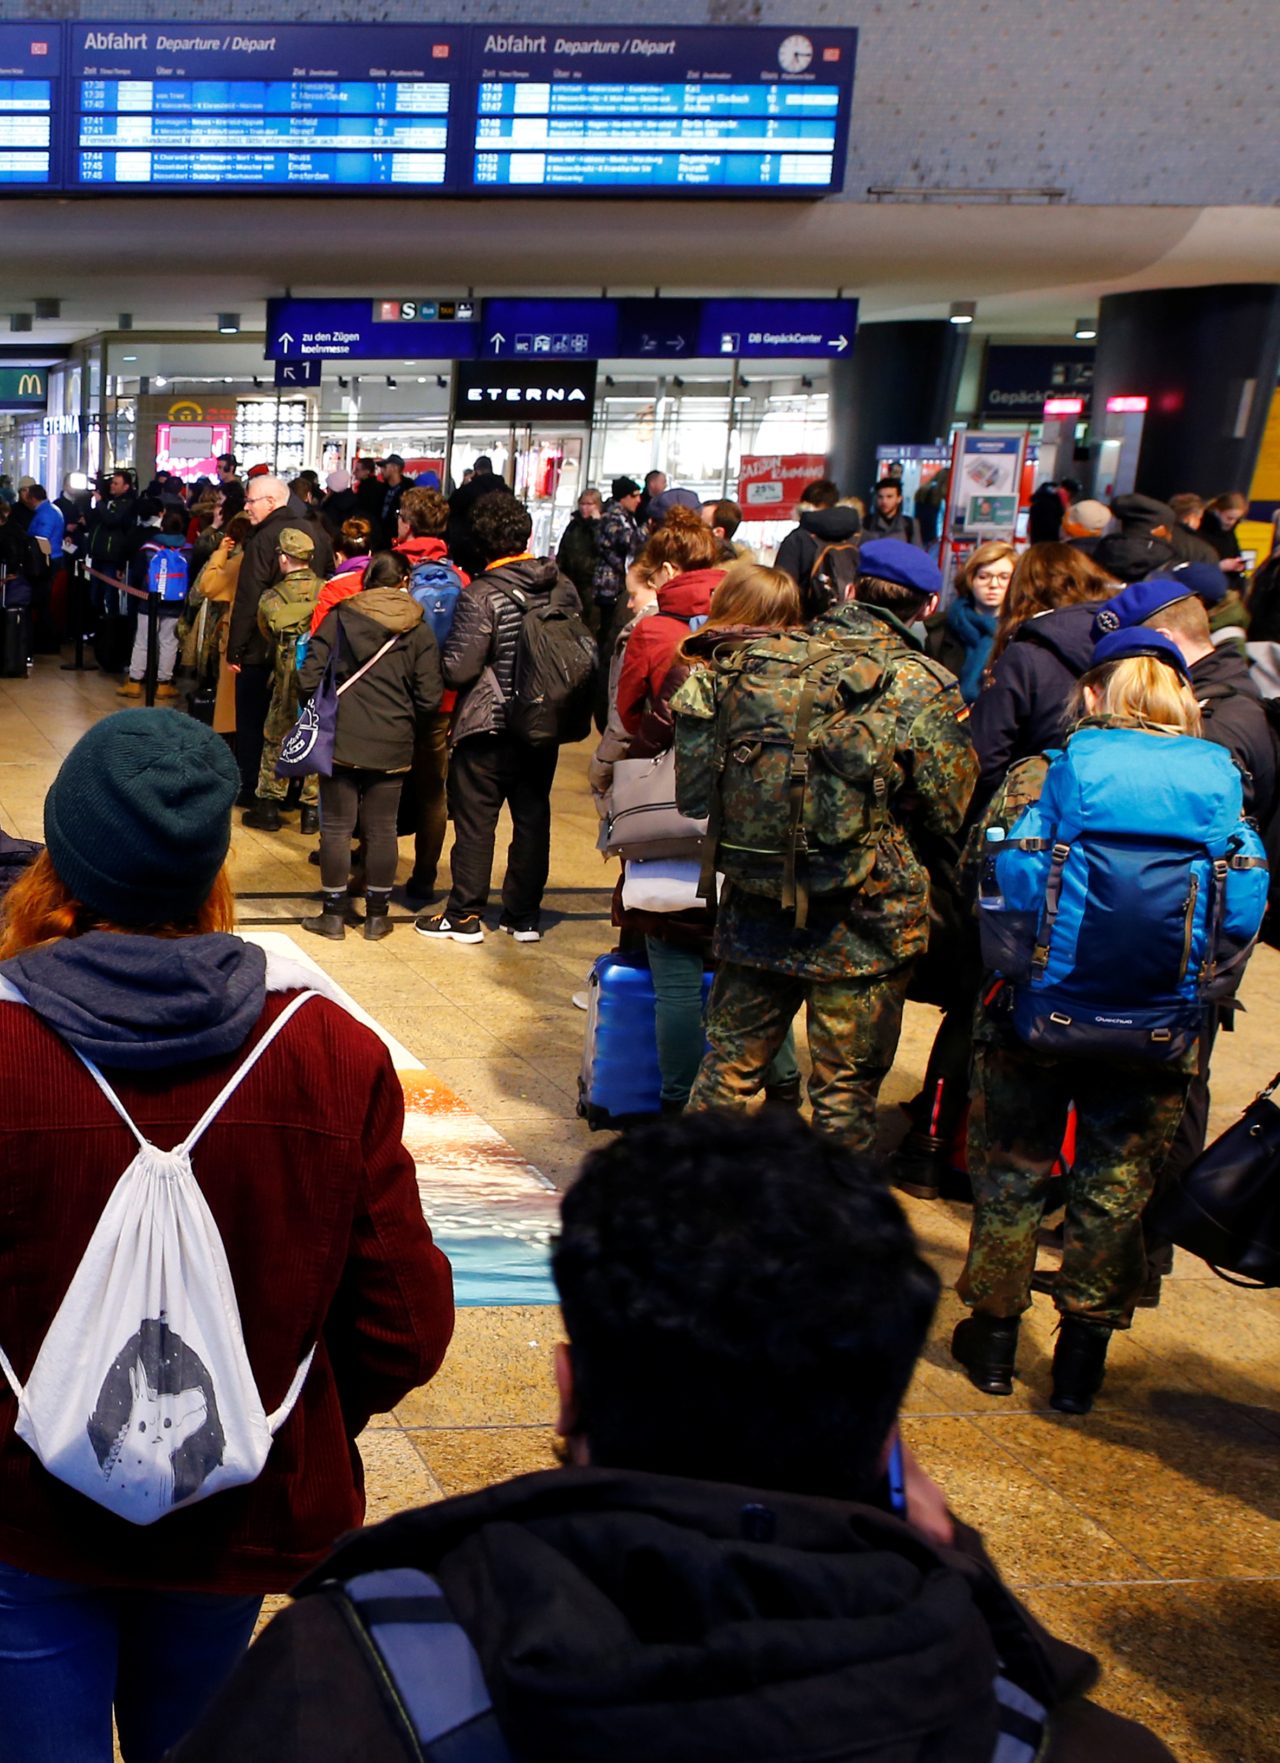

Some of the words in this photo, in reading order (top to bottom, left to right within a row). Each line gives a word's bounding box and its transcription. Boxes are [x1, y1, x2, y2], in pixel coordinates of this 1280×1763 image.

[85, 33, 147, 49] Abfahrt
[156, 36, 220, 52] Departure
[232, 37, 276, 53] Départ
[485, 35, 546, 53] Abfahrt
[554, 39, 620, 56] Departure
[630, 39, 675, 56] Départ
[402, 303, 416, 320] S
[302, 334, 313, 342] zu
[314, 332, 331, 342] den
[332, 331, 360, 343] Zügen
[301, 344, 350, 354] koelnmesse
[302, 362, 311, 379] 1
[467, 388, 586, 401] ETERNA
[43, 415, 80, 436] ETERNA
